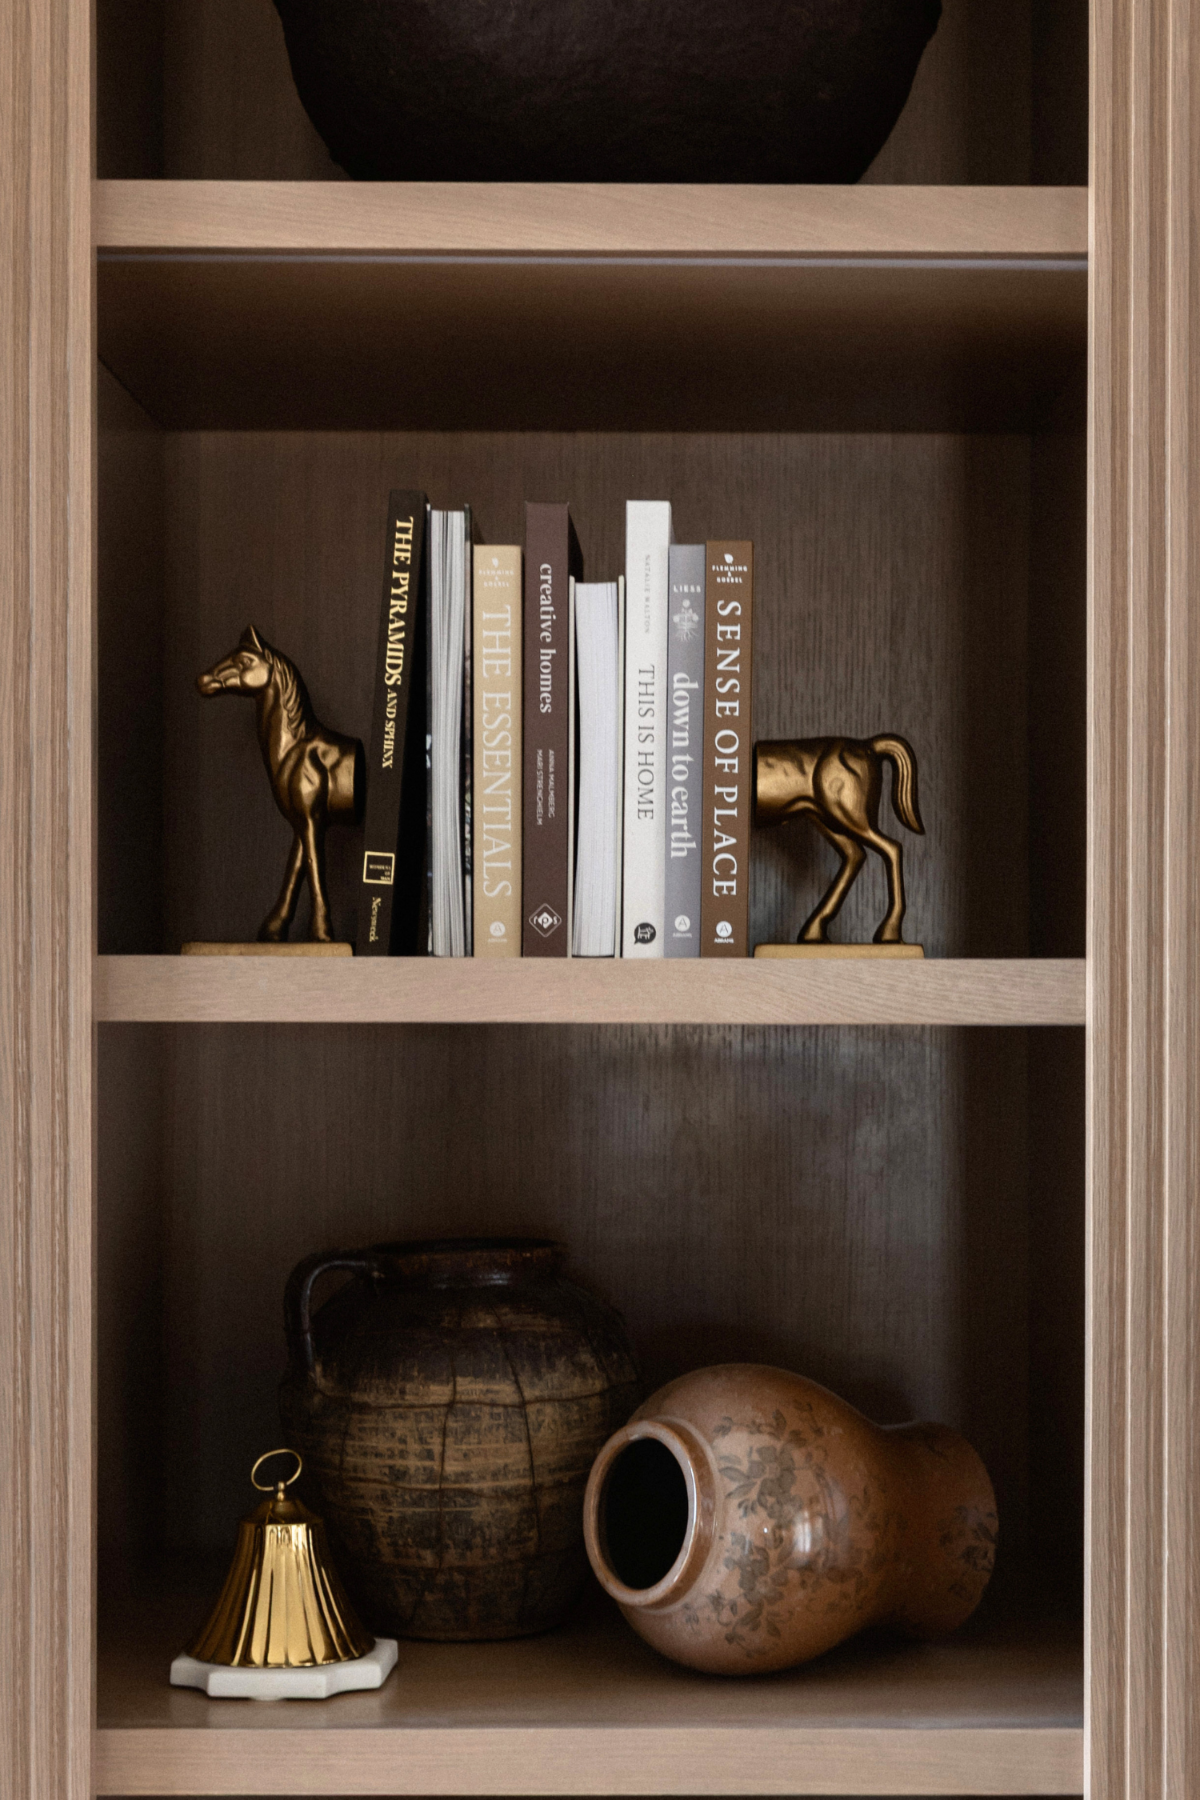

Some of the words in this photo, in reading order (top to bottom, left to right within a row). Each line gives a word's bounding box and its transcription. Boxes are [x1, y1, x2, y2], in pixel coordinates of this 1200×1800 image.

[393, 516, 414, 565] THE
[384, 571, 410, 686] PYRAMIDS
[539, 563, 556, 642] creative
[482, 604, 511, 678] THE
[715, 600, 742, 718] SENSE
[386, 689, 398, 719] AND
[539, 648, 556, 713] homes
[638, 664, 654, 718] THIS
[672, 672, 699, 748] down
[382, 720, 396, 769] SPHINX
[638, 724, 654, 744] IS
[671, 753, 694, 782] to
[714, 729, 739, 774] OF
[482, 691, 512, 898] ESSENTIALS
[637, 751, 654, 820] HOME
[670, 786, 697, 859] earth
[712, 784, 738, 898] PLACE
